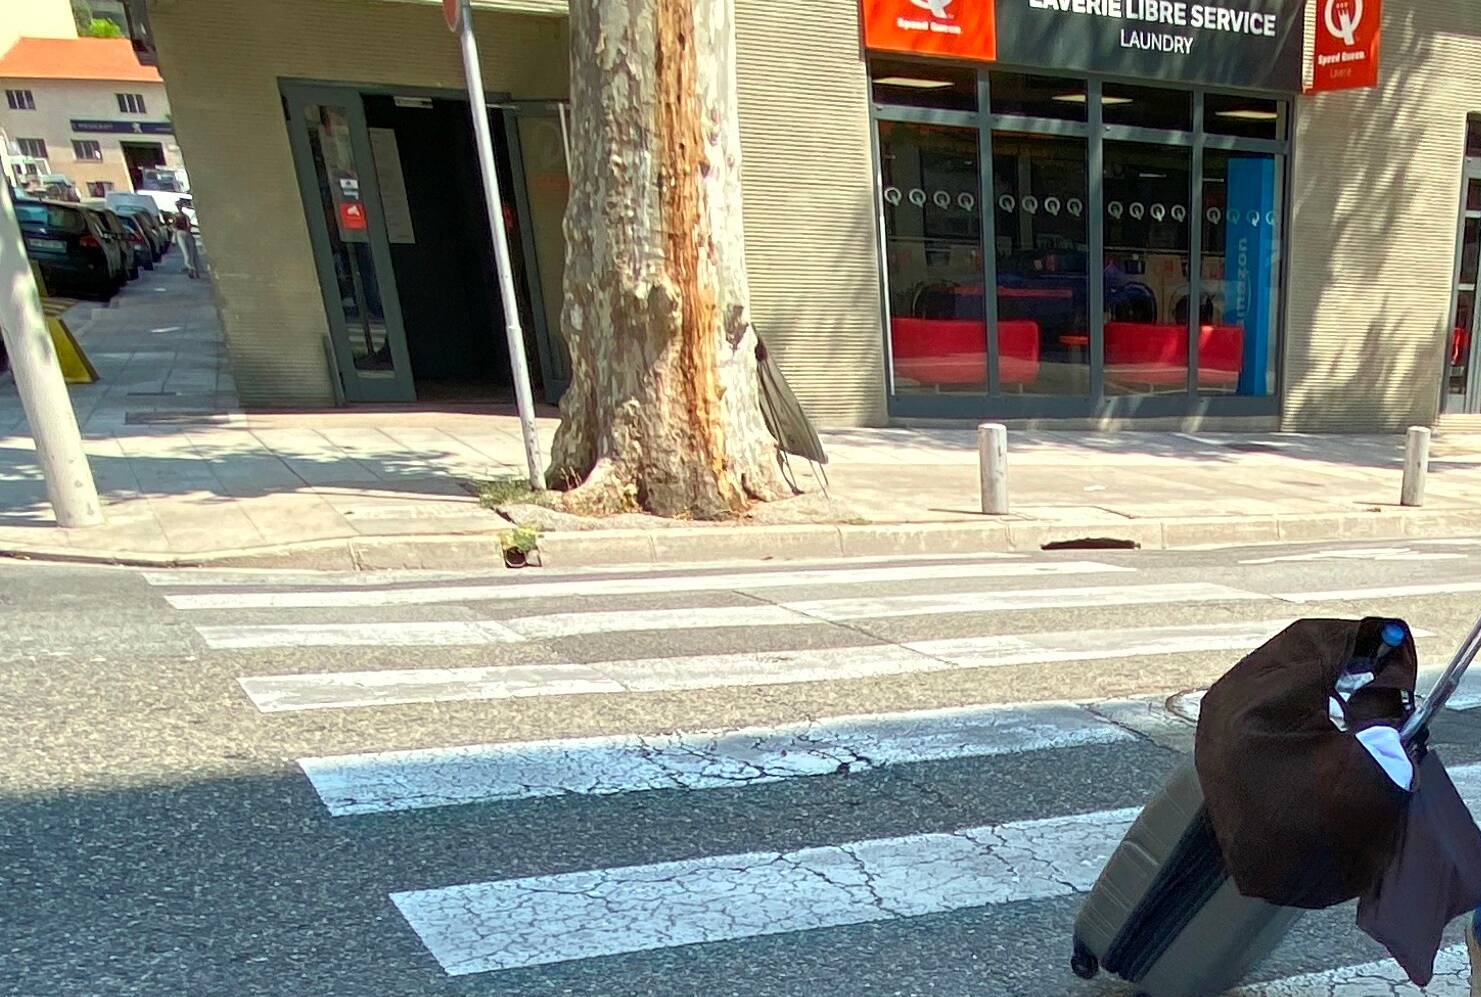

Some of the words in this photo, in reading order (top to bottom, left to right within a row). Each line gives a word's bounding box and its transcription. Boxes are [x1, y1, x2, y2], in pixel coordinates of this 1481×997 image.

[1125, 0, 1187, 26] LIBRE
[1190, 4, 1277, 37] SERVICE
[1120, 28, 1194, 54] LAUNDRY
